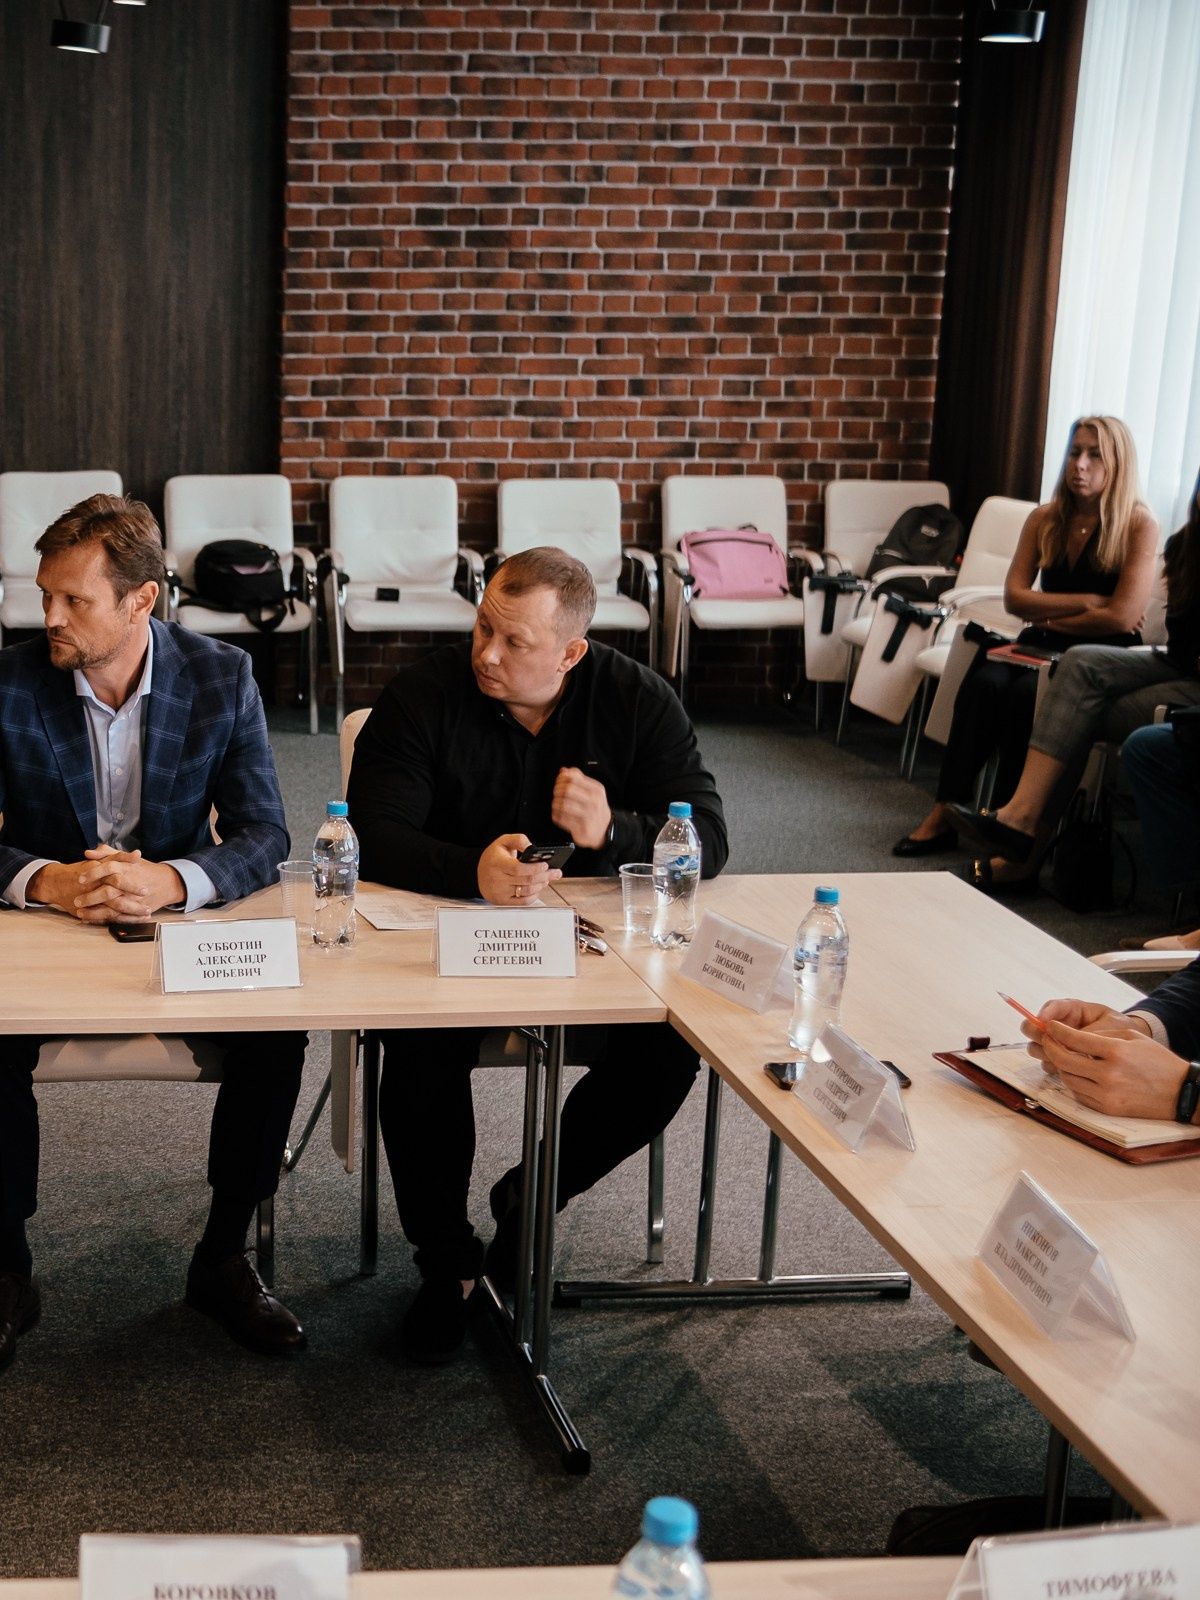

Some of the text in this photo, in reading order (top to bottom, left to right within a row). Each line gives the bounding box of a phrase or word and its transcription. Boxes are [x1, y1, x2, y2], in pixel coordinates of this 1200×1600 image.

[474, 930, 540, 939] СТАЦЕНКО
[198, 941, 262, 952] СУББОТИН
[478, 941, 537, 952] ДМИТРИЙ
[714, 940, 754, 965] БАРОНОВА
[196, 954, 267, 966] АЛЕКСАНДР
[473, 956, 542, 965] СЕРГЕЕВИЧ
[712, 954, 745, 976] ЛЮБОВЬ
[203, 968, 262, 979] ЮРЬЕВИЧ
[702, 963, 746, 992] БОРИСОВНА
[1020, 1220, 1060, 1263] НИКОНОВ
[1015, 1237, 1049, 1278] МАКСИМ
[1043, 1569, 1177, 1598] ТИМОФЕЕВА
